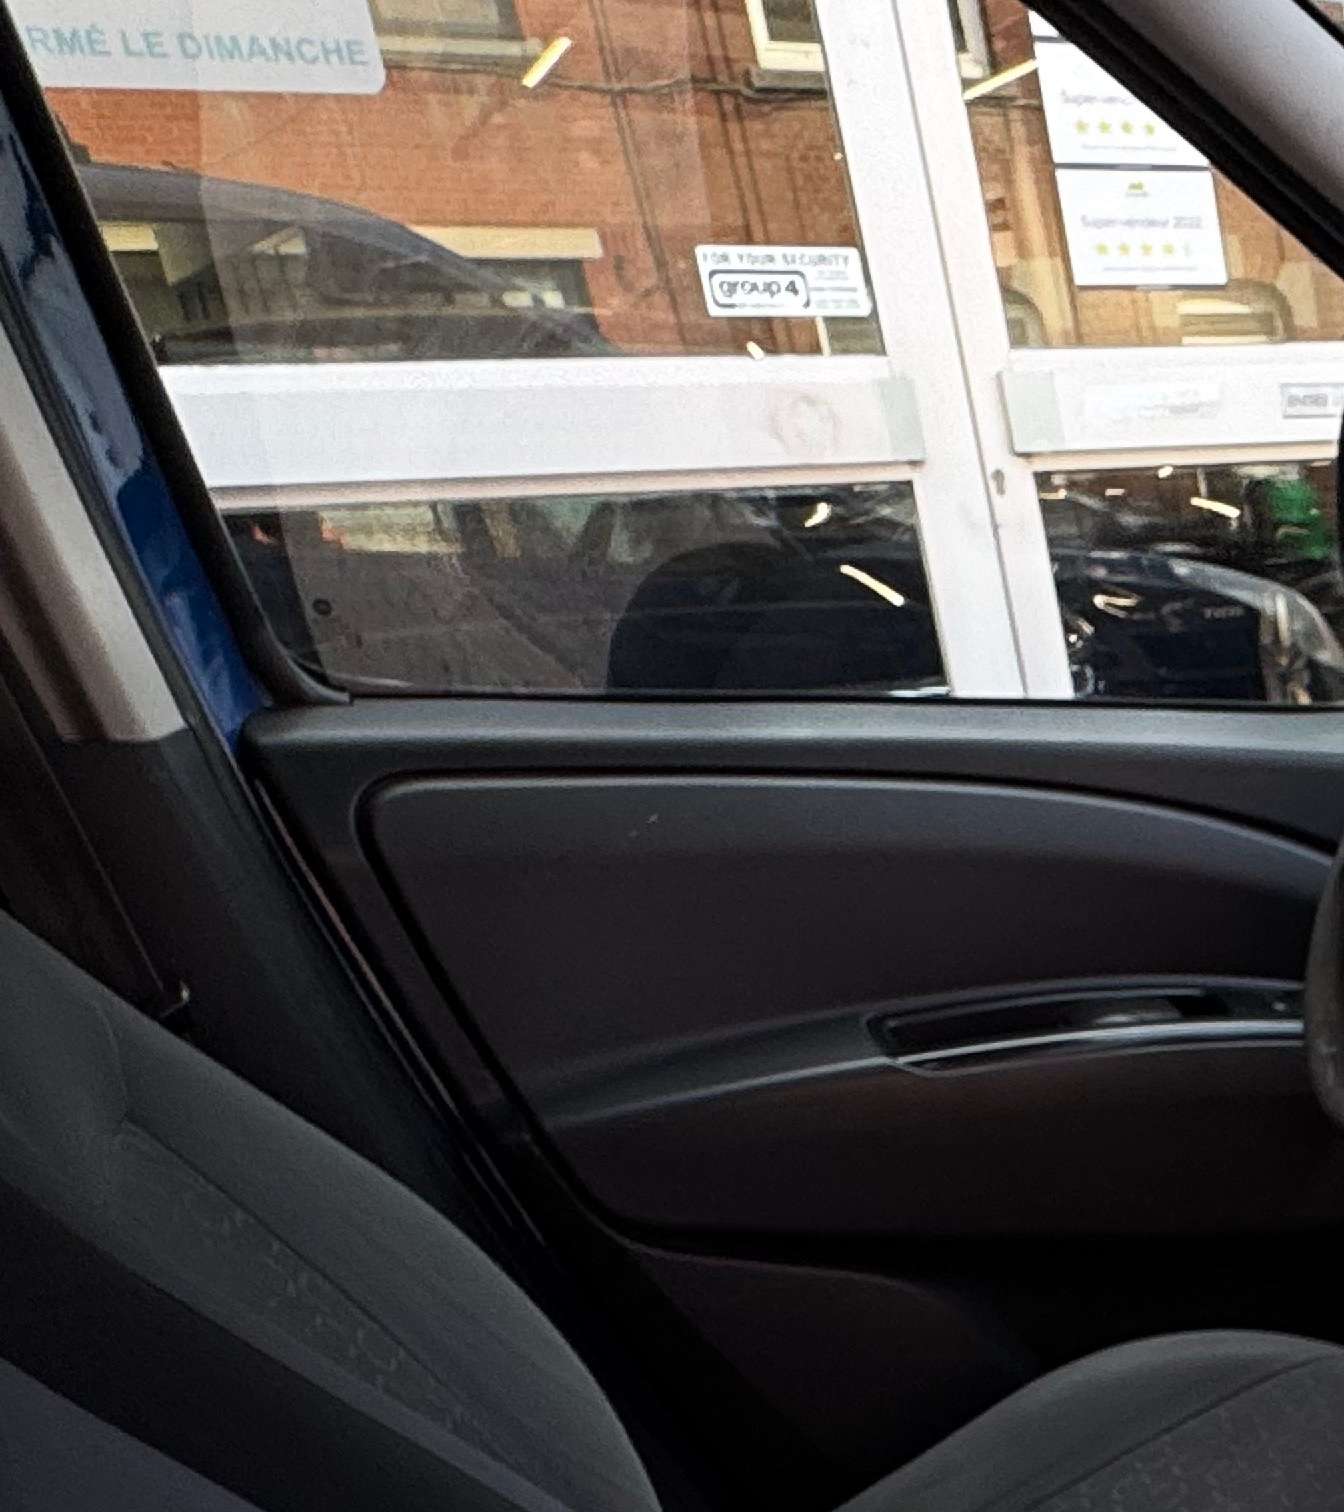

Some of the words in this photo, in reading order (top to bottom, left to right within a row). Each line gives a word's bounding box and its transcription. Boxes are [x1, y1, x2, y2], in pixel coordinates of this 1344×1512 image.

[26, 24, 112, 58] RMÉ
[120, 28, 168, 59] LE
[176, 31, 370, 67] DIMANCHE
[719, 280, 782, 299] group
[784, 279, 799, 297] 4
